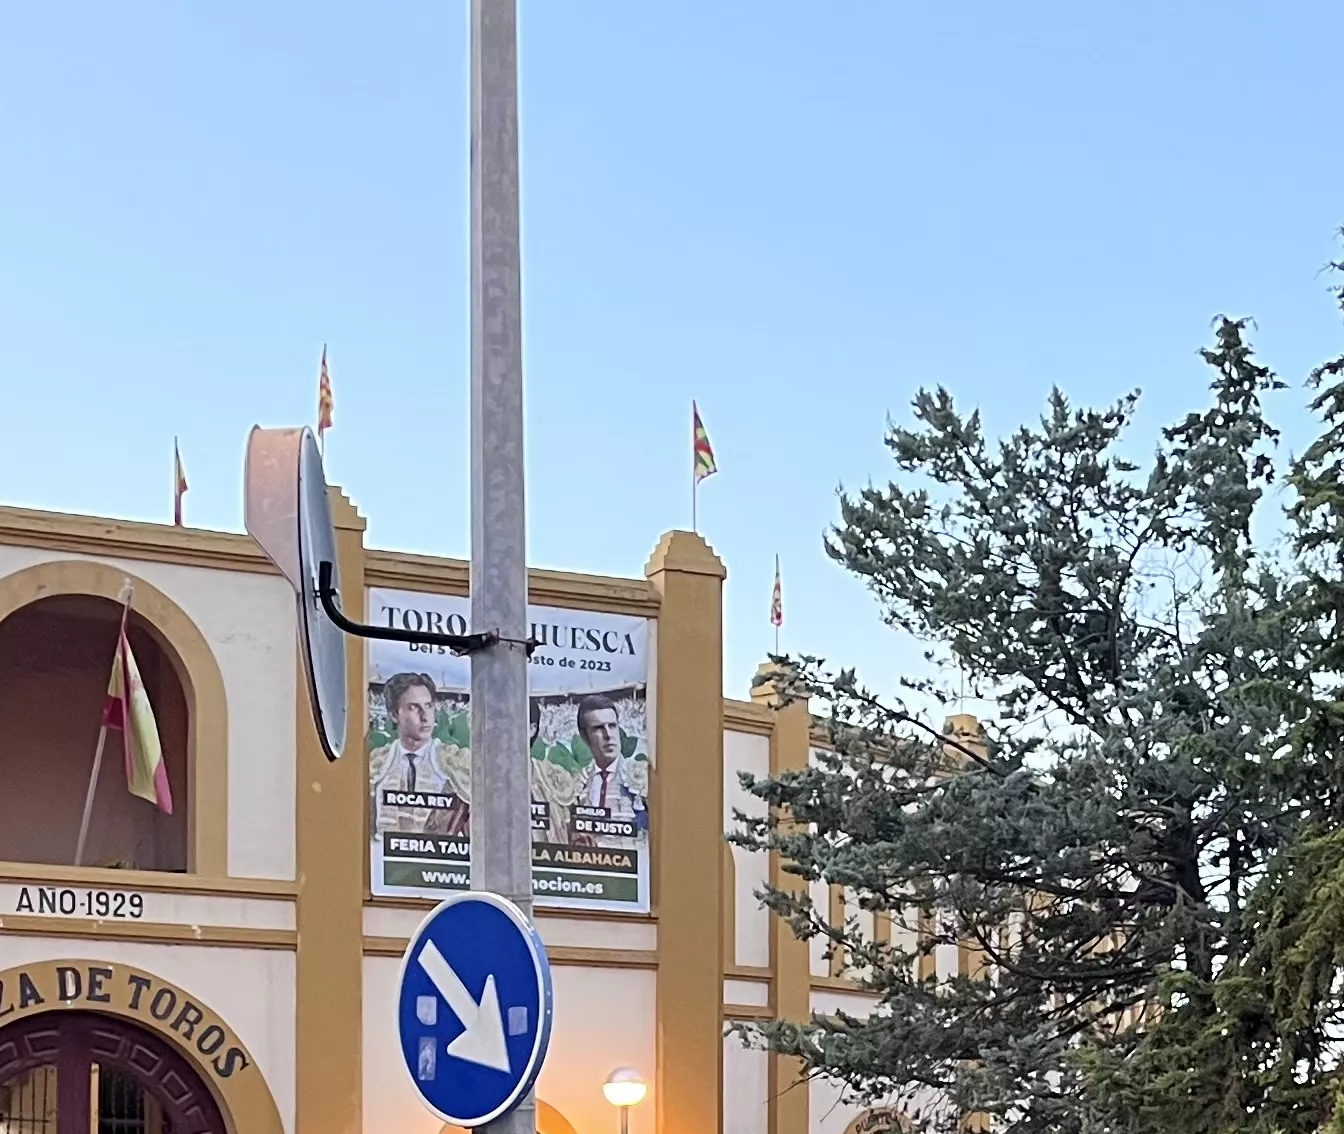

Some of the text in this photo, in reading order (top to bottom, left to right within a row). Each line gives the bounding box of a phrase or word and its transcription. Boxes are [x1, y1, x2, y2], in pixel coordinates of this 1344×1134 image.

[381, 606, 636, 655] TORO HUESCA
[559, 657, 576, 668] de
[580, 660, 611, 672] 2023
[387, 793, 453, 807] ROCA REY
[576, 820, 633, 835] DE JUSTO
[390, 838, 436, 853] FERIA
[554, 850, 632, 867] ALBAHACA
[56, 966, 113, 1002] DE
[128, 974, 249, 1078] TOROS
